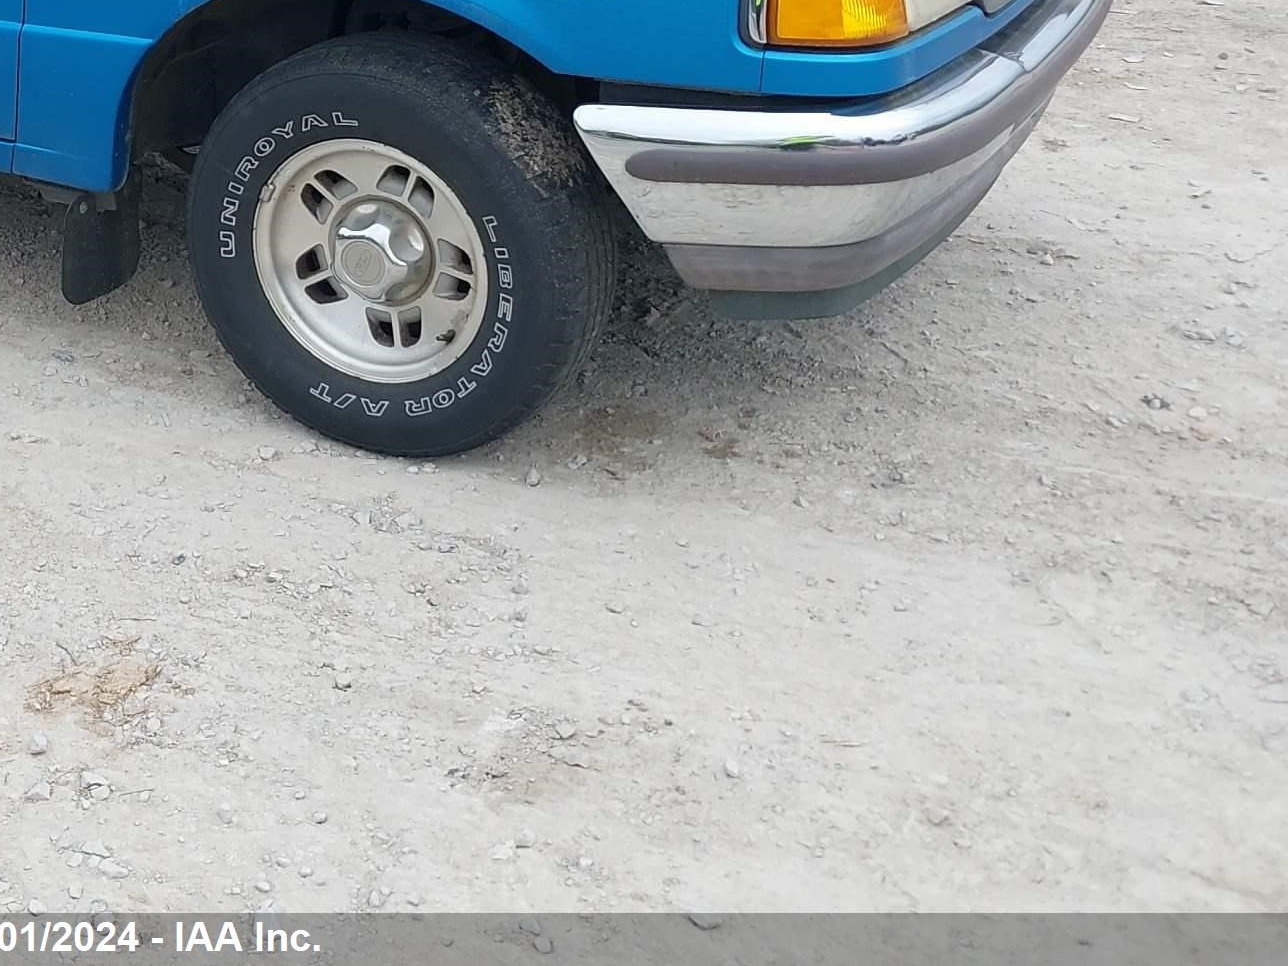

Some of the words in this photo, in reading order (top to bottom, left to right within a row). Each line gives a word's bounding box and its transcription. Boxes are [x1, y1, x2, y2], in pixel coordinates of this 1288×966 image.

[219, 111, 358, 258] UNIROYAL
[404, 215, 514, 416] LIBERATOR
[309, 381, 390, 417] A/T
